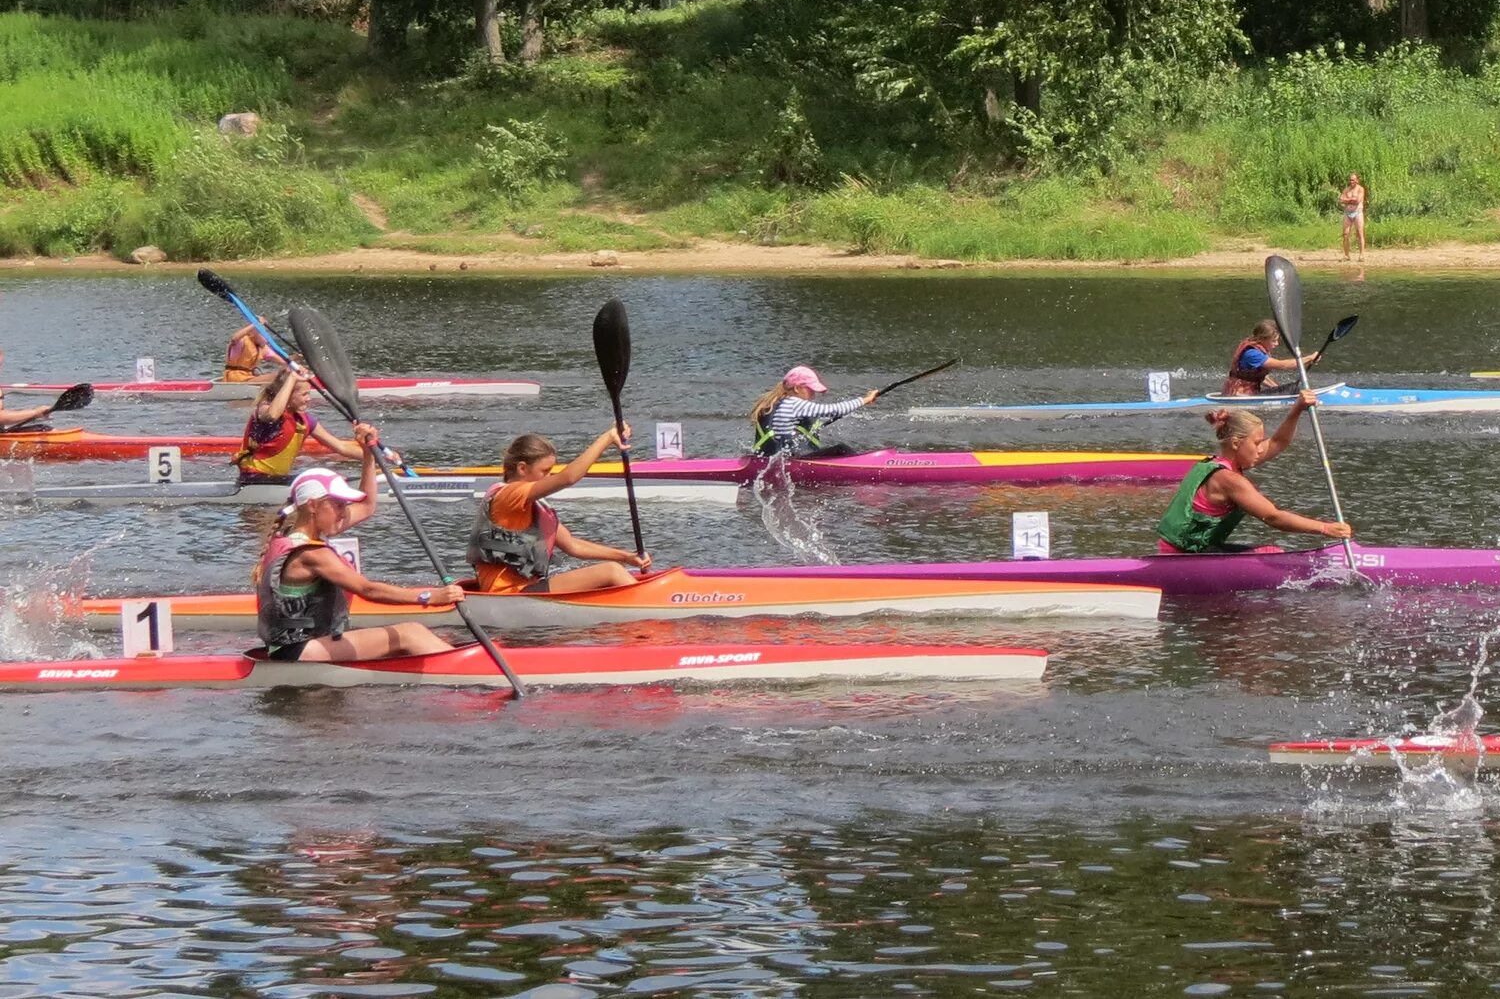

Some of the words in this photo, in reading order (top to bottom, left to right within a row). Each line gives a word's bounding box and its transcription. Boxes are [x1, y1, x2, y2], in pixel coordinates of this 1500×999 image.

[1152, 379, 1169, 394] 16
[660, 431, 681, 449] 14
[158, 452, 172, 477] 5
[1021, 531, 1045, 548] 11
[136, 602, 160, 651] 1
